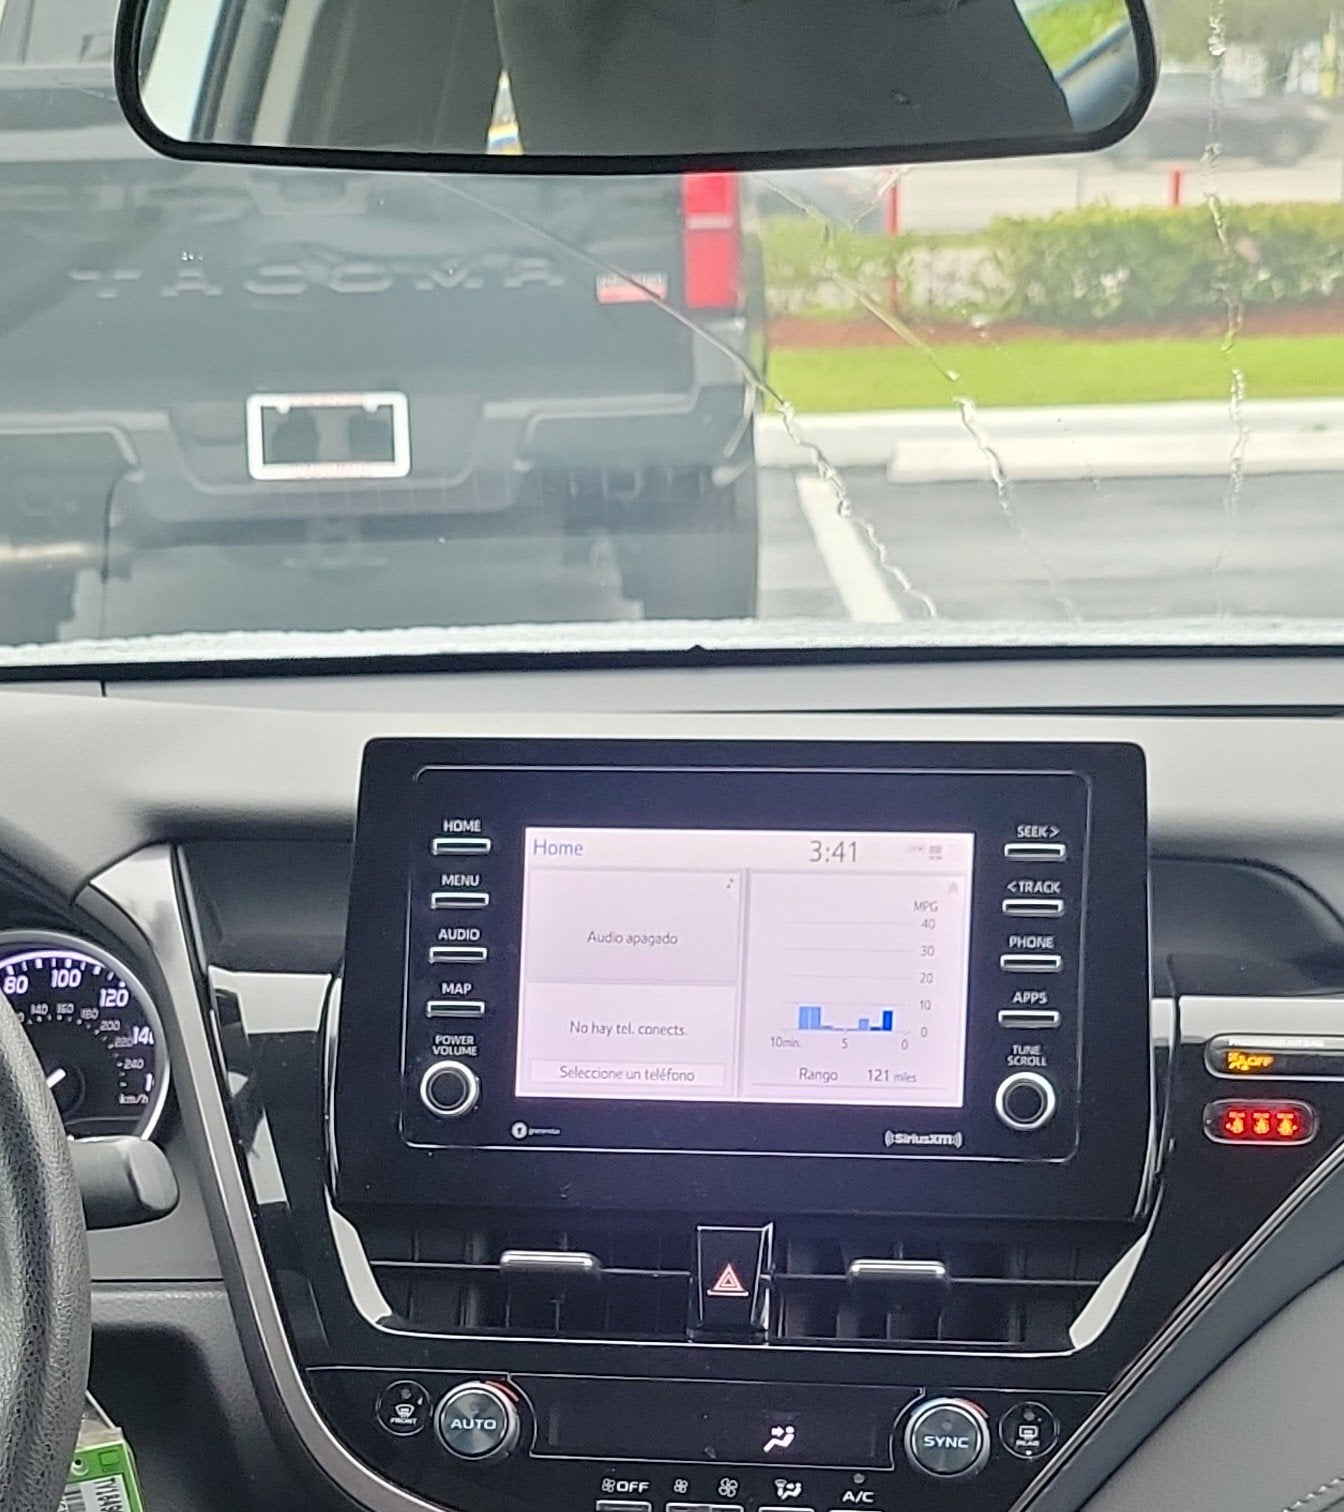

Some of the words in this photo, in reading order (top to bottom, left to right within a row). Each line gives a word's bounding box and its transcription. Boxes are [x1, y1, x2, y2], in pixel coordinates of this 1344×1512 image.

[68, 256, 564, 297] TACOMA
[443, 819, 481, 832] HOME
[533, 839, 583, 856] Home
[809, 840, 858, 863] 3:41
[441, 874, 480, 886] MENU
[914, 901, 938, 913] MPG
[921, 919, 936, 930] 40
[438, 929, 480, 941] AUDIO
[587, 931, 623, 944] Audio
[626, 933, 678, 947] apagado
[1009, 936, 1054, 949] PHONE
[921, 946, 934, 957] 30
[51, 969, 81, 988] 100
[920, 973, 933, 984] 20
[3, 976, 29, 994] 80
[441, 982, 472, 995] MAP
[99, 988, 129, 1007] 120
[1013, 992, 1048, 1004] APPS
[920, 1000, 931, 1011] 10
[570, 1021, 588, 1034] No
[592, 1021, 613, 1037] hay
[616, 1022, 635, 1035] tel.
[638, 1023, 688, 1036] conects.
[920, 1027, 928, 1038] 0
[435, 1035, 474, 1045] POWER
[841, 1038, 848, 1049] 5
[901, 1039, 908, 1050] 0
[432, 1045, 478, 1056] VOLUME
[1012, 1045, 1041, 1055] TUNE
[1007, 1056, 1047, 1066] SCROLL
[1248, 1055, 1274, 1067] OFF
[559, 1065, 622, 1080] Seleccione
[626, 1070, 641, 1080] un
[645, 1066, 695, 1082] teléfono
[799, 1068, 838, 1082] Rango
[867, 1069, 889, 1082] 121
[450, 1418, 497, 1430] AUTO
[923, 1436, 969, 1449] SYNC
[616, 1481, 649, 1492] OFF
[842, 1490, 875, 1503] A/C
